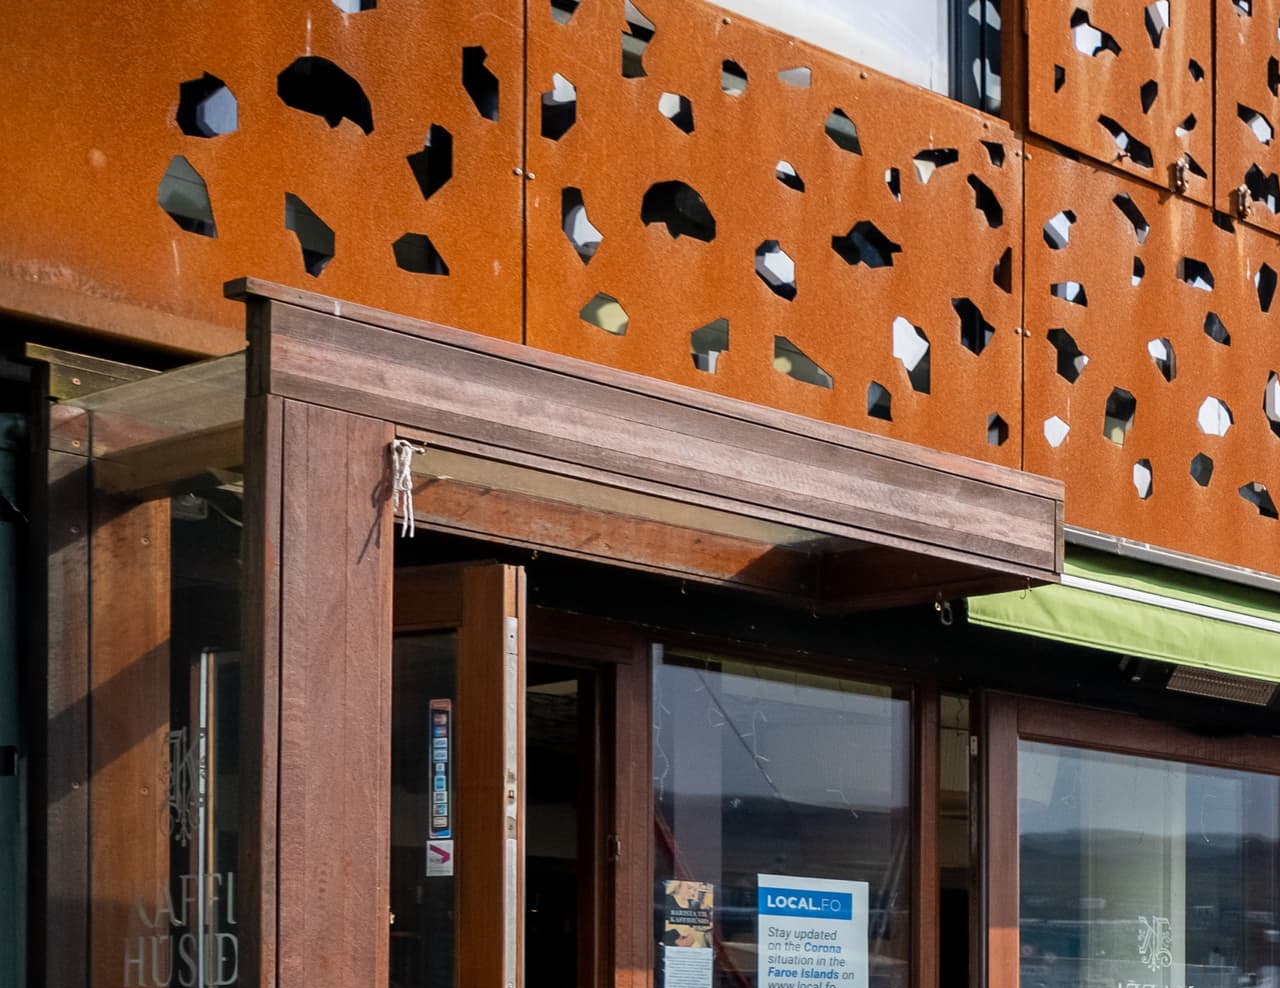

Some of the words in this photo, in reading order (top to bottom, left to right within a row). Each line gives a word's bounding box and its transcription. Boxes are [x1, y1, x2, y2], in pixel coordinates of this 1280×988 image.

[767, 895, 841, 912] LOCAL.FO
[768, 927, 791, 940] Stay
[794, 929, 837, 943] updated
[768, 942, 781, 951] on
[784, 941, 801, 952] the
[804, 942, 842, 953] Corona
[768, 955, 814, 966] situation
[817, 957, 826, 966] in
[829, 957, 846, 967] the
[768, 967, 798, 978] Faroe
[800, 968, 839, 980] Islands
[841, 971, 854, 980] on
